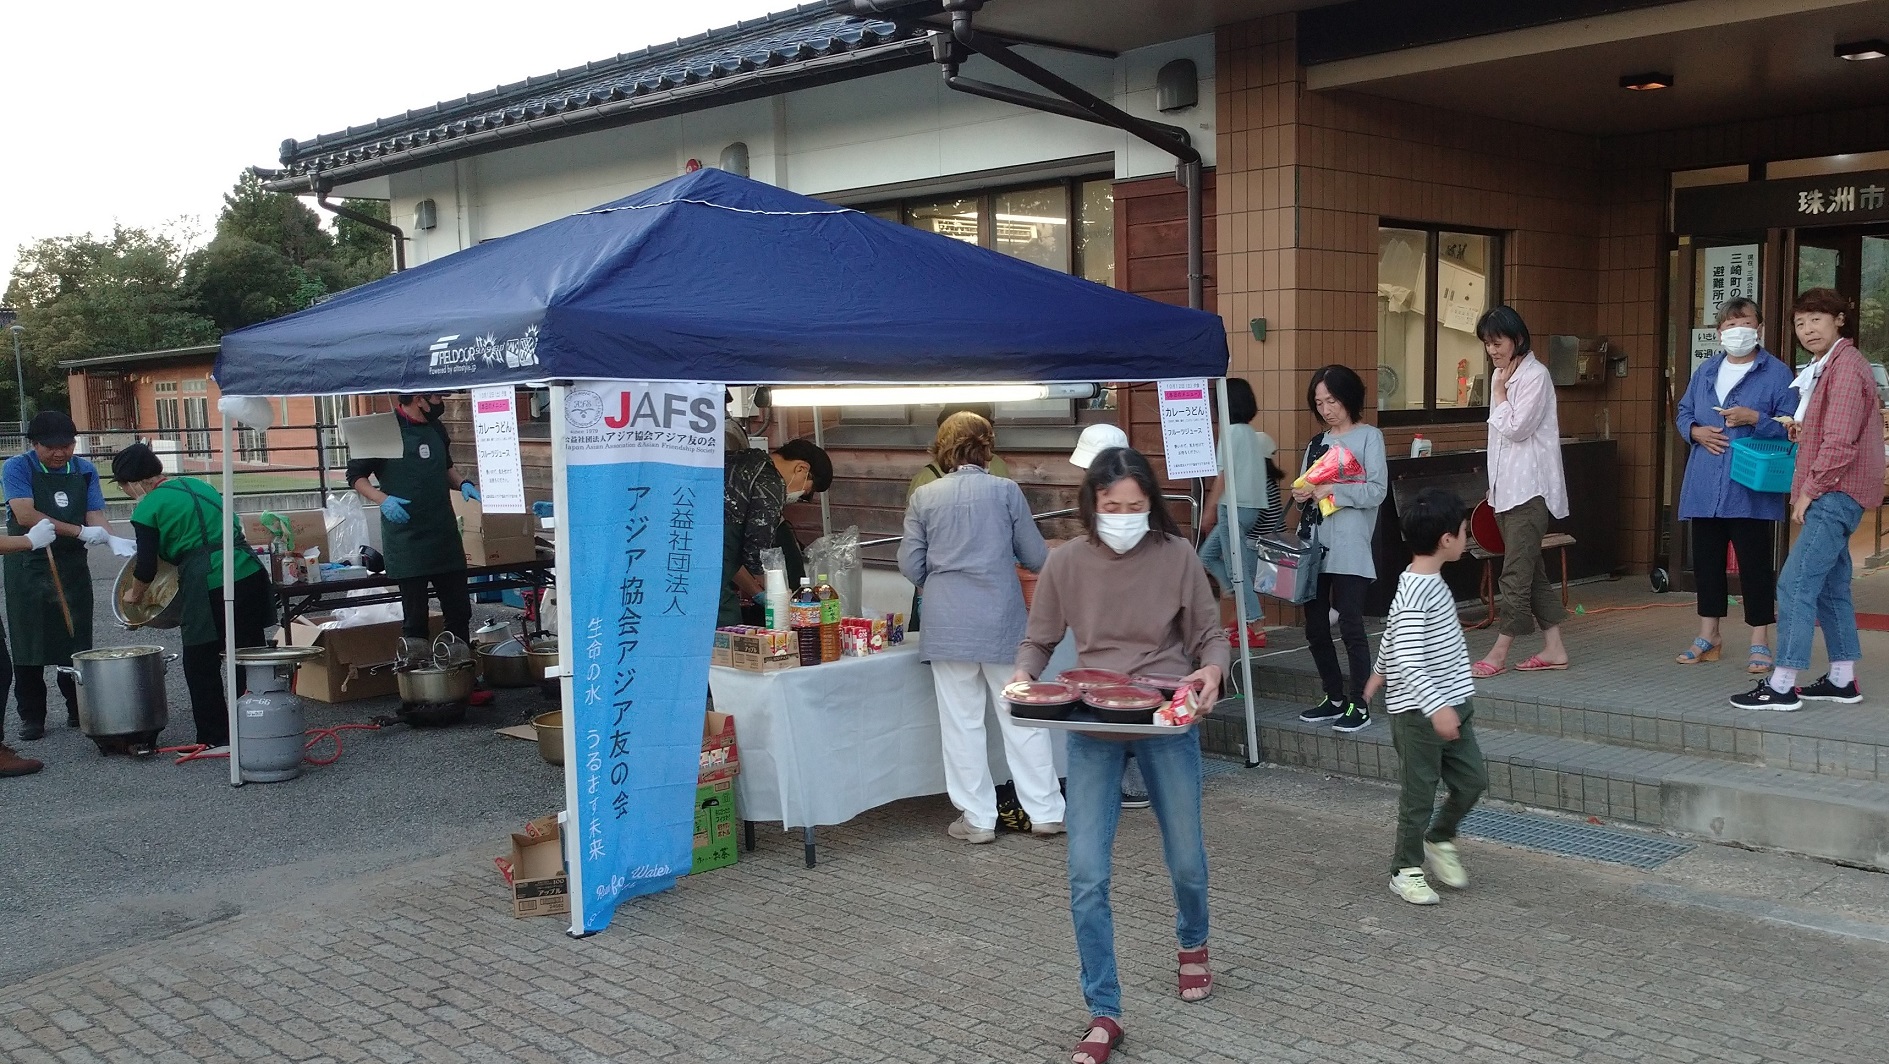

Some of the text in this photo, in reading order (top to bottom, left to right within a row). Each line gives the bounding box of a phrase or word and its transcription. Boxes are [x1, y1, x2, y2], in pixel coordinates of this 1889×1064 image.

[1798, 184, 1886, 214] 珠洲市
[1730, 253, 1742, 298] 三崎町の
[604, 391, 717, 434] JAFS
[1166, 406, 1204, 417] カレーうどん
[478, 421, 512, 434] カレーうどん
[1168, 428, 1202, 436] フルーツジュース
[480, 450, 510, 458] フルーツジュース
[662, 442, 695, 453] Friendship
[662, 486, 696, 616] 公益社団法人
[609, 486, 651, 820] アジア協会アジア友の会
[585, 618, 606, 861] 生命の水 うるおす未来
[631, 864, 672, 879] Water
[538, 888, 562, 896] アップル
